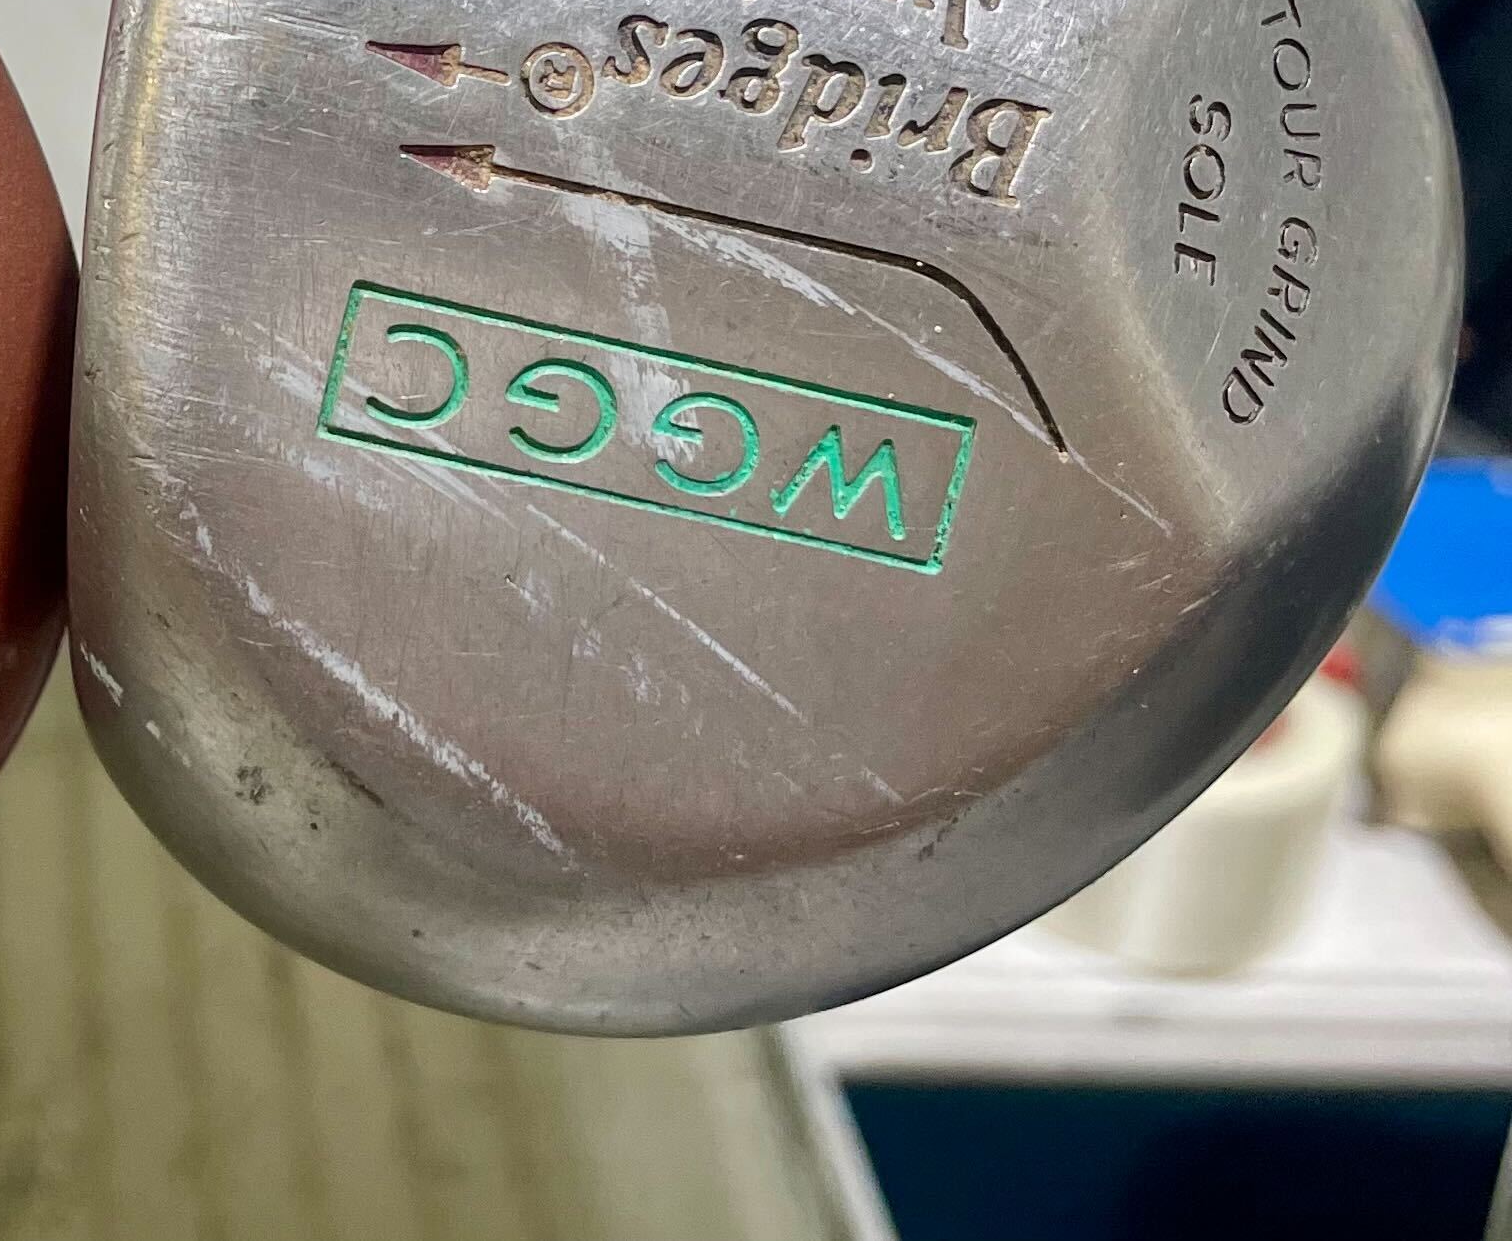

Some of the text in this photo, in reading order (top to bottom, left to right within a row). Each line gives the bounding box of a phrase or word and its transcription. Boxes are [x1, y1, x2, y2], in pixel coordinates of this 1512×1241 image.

[1173, 93, 1232, 286] SOLE
[1222, 216, 1318, 426] GRIND
[365, 323, 906, 541] WGGC
